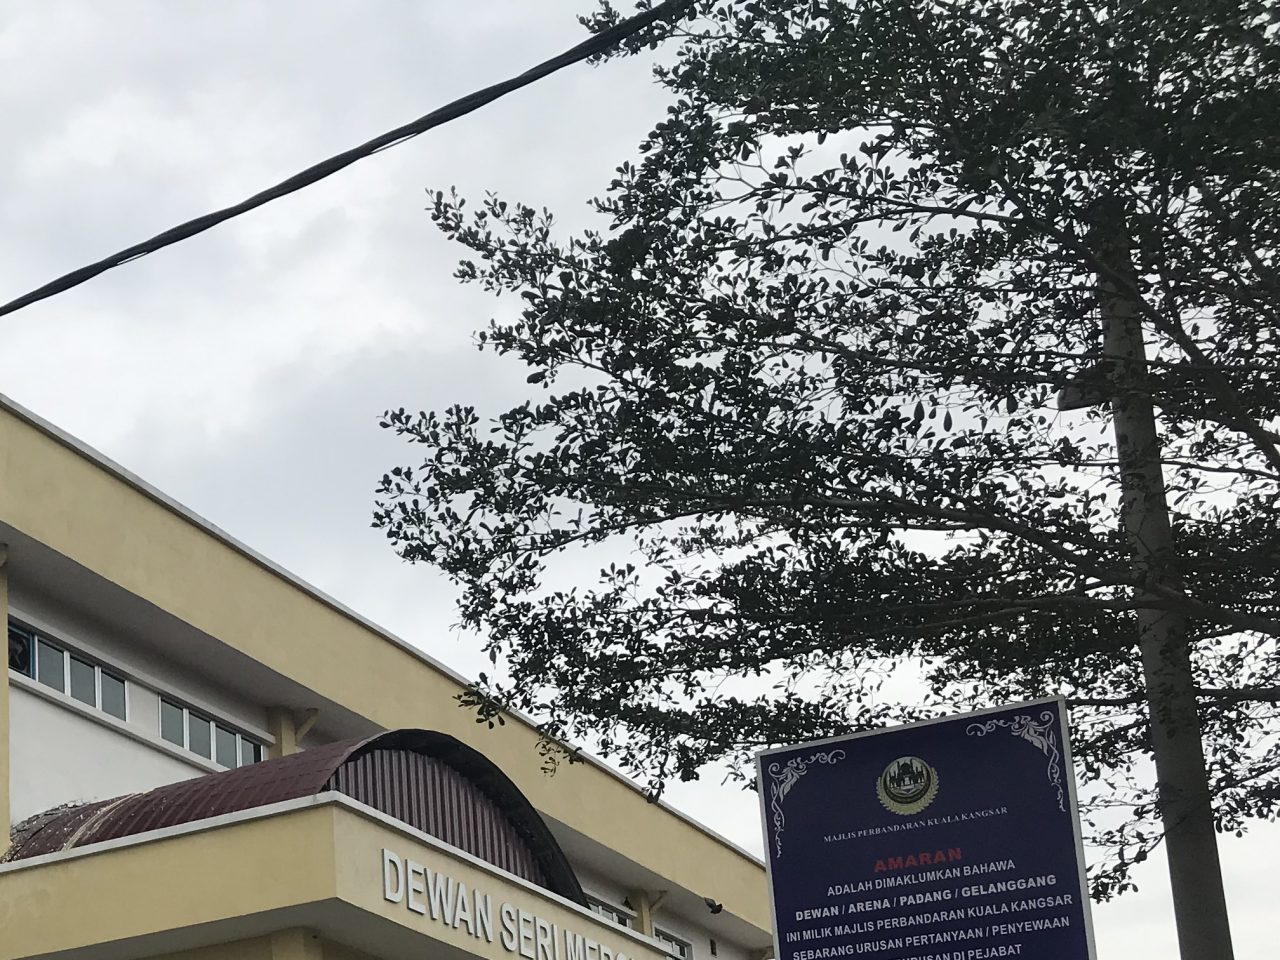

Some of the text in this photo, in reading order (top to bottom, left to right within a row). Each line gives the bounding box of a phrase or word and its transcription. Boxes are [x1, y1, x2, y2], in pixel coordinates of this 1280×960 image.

[823, 806, 1008, 843] MAJLIS PERBANDARAN KUALA KANGSAR
[827, 859, 1016, 896] ADALAH DIMAKLUMKAN BAHAWA
[874, 848, 961, 873] AMARAN
[382, 848, 493, 943] DEWAN
[795, 906, 839, 921] DEWAN
[848, 898, 891, 914] ARENA
[900, 890, 952, 907] PADANG
[961, 874, 1057, 898] GELANGGANG
[786, 894, 1073, 943] INI MILIK MAJLIS PERBANDARAN KUALA KANGSAR
[793, 944, 854, 960] SEBARANG
[856, 938, 903, 953] URUSAN
[905, 927, 983, 947] PERTANYAAN
[992, 916, 1070, 936] PENYEWAAN
[968, 944, 1022, 960] PEJABAT
